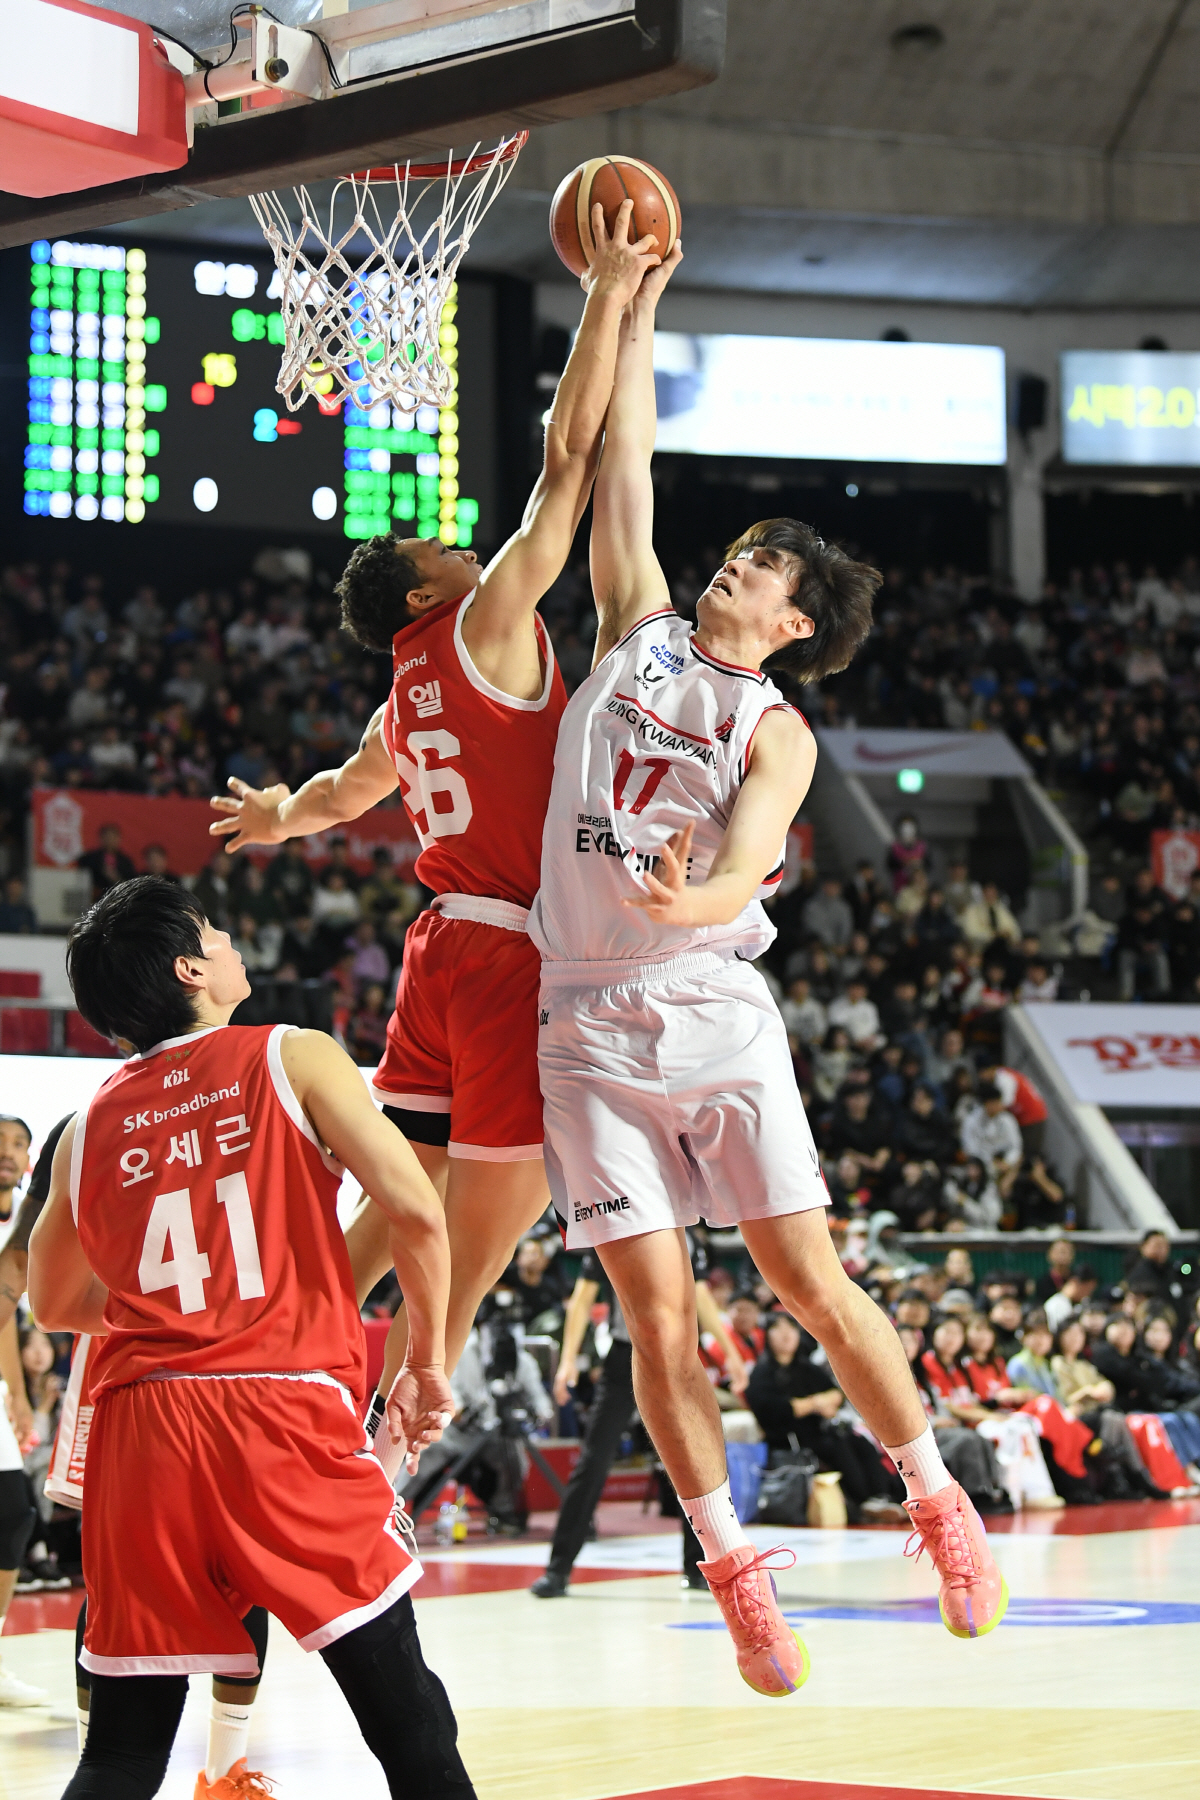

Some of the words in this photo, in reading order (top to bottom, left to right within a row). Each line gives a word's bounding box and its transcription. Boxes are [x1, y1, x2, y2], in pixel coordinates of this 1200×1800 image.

[649, 645, 685, 676] COFFEE
[603, 699, 640, 725] JUNG
[612, 747, 673, 815] 17
[577, 813, 613, 829] 에브리타
[123, 1110, 152, 1134] SK
[153, 1081, 241, 1124] broadband
[137, 1170, 266, 1315] 41
